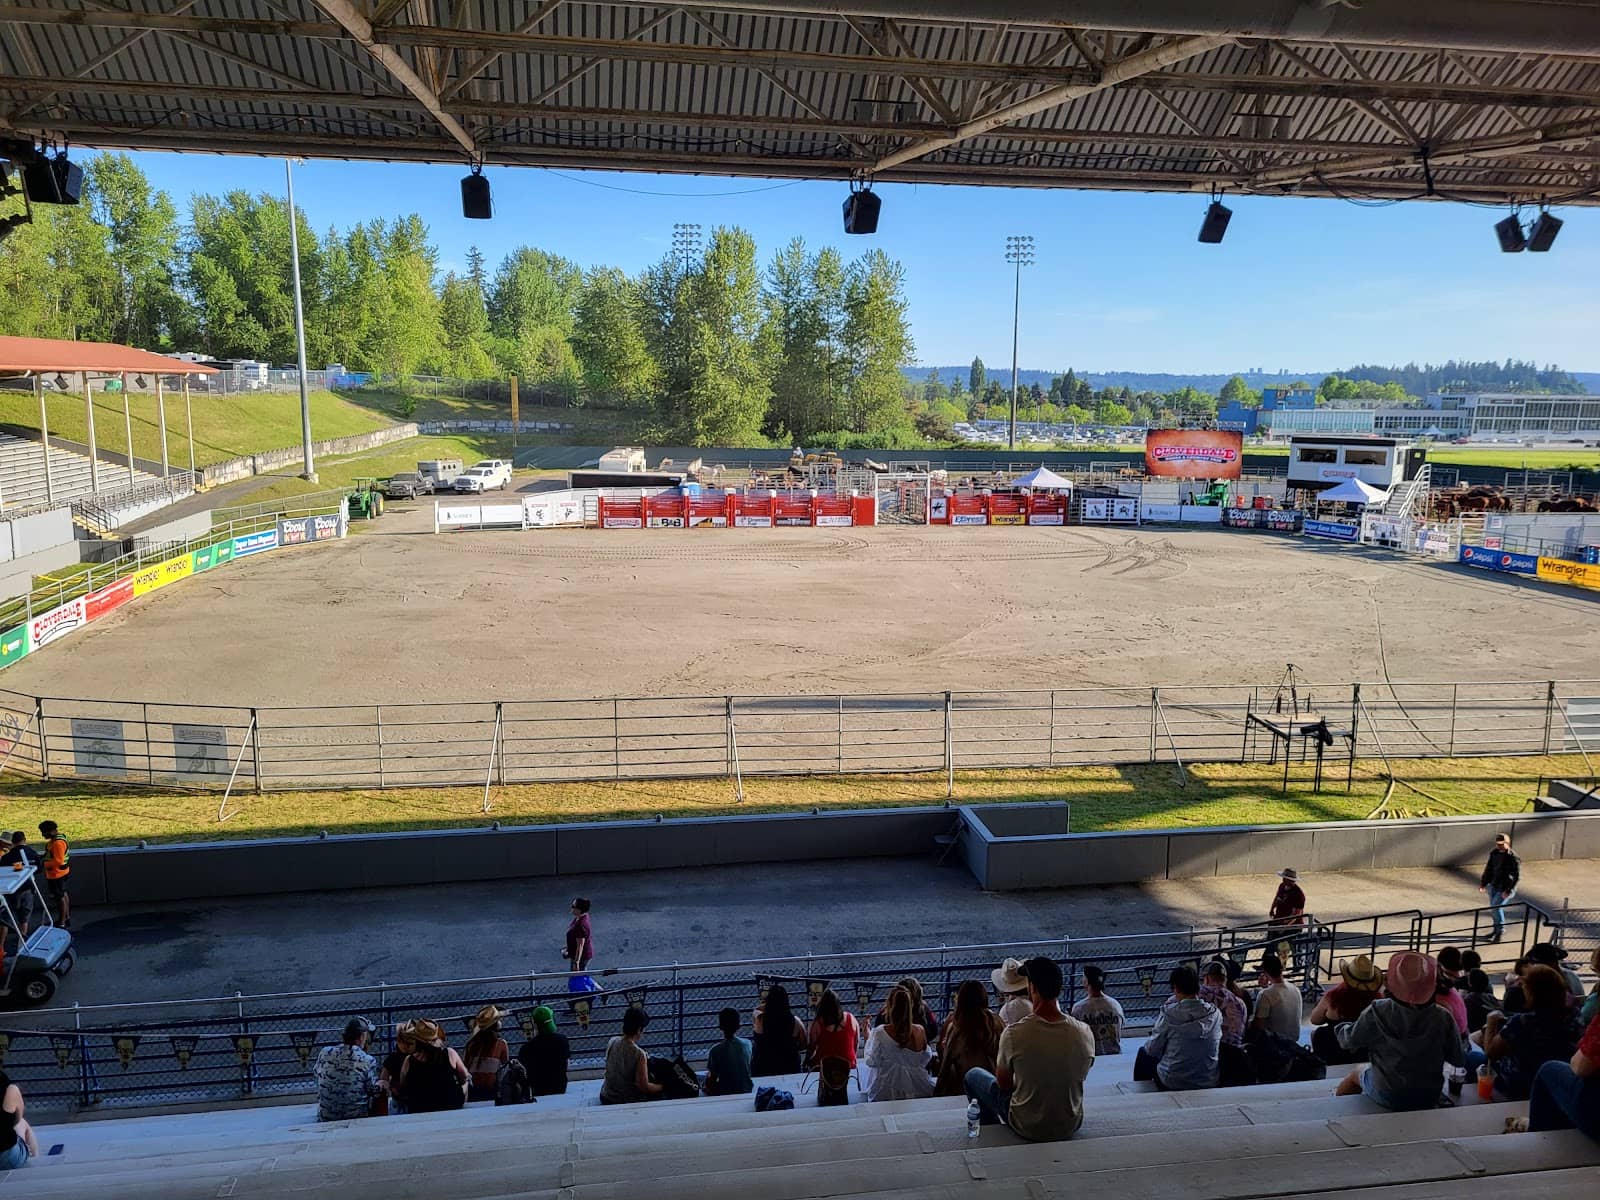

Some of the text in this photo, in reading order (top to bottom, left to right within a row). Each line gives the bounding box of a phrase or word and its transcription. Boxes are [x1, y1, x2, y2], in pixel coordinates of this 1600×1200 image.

[1154, 447, 1235, 459] CLOVERDALE
[1229, 508, 1256, 520] Coors
[1267, 510, 1295, 522] Coors
[1472, 552, 1494, 563] pepsi
[1511, 559, 1534, 569] pepsi
[1542, 559, 1588, 580] Wrangler
[135, 568, 161, 588] Wrangler
[33, 602, 82, 639] CLOVERDALE
